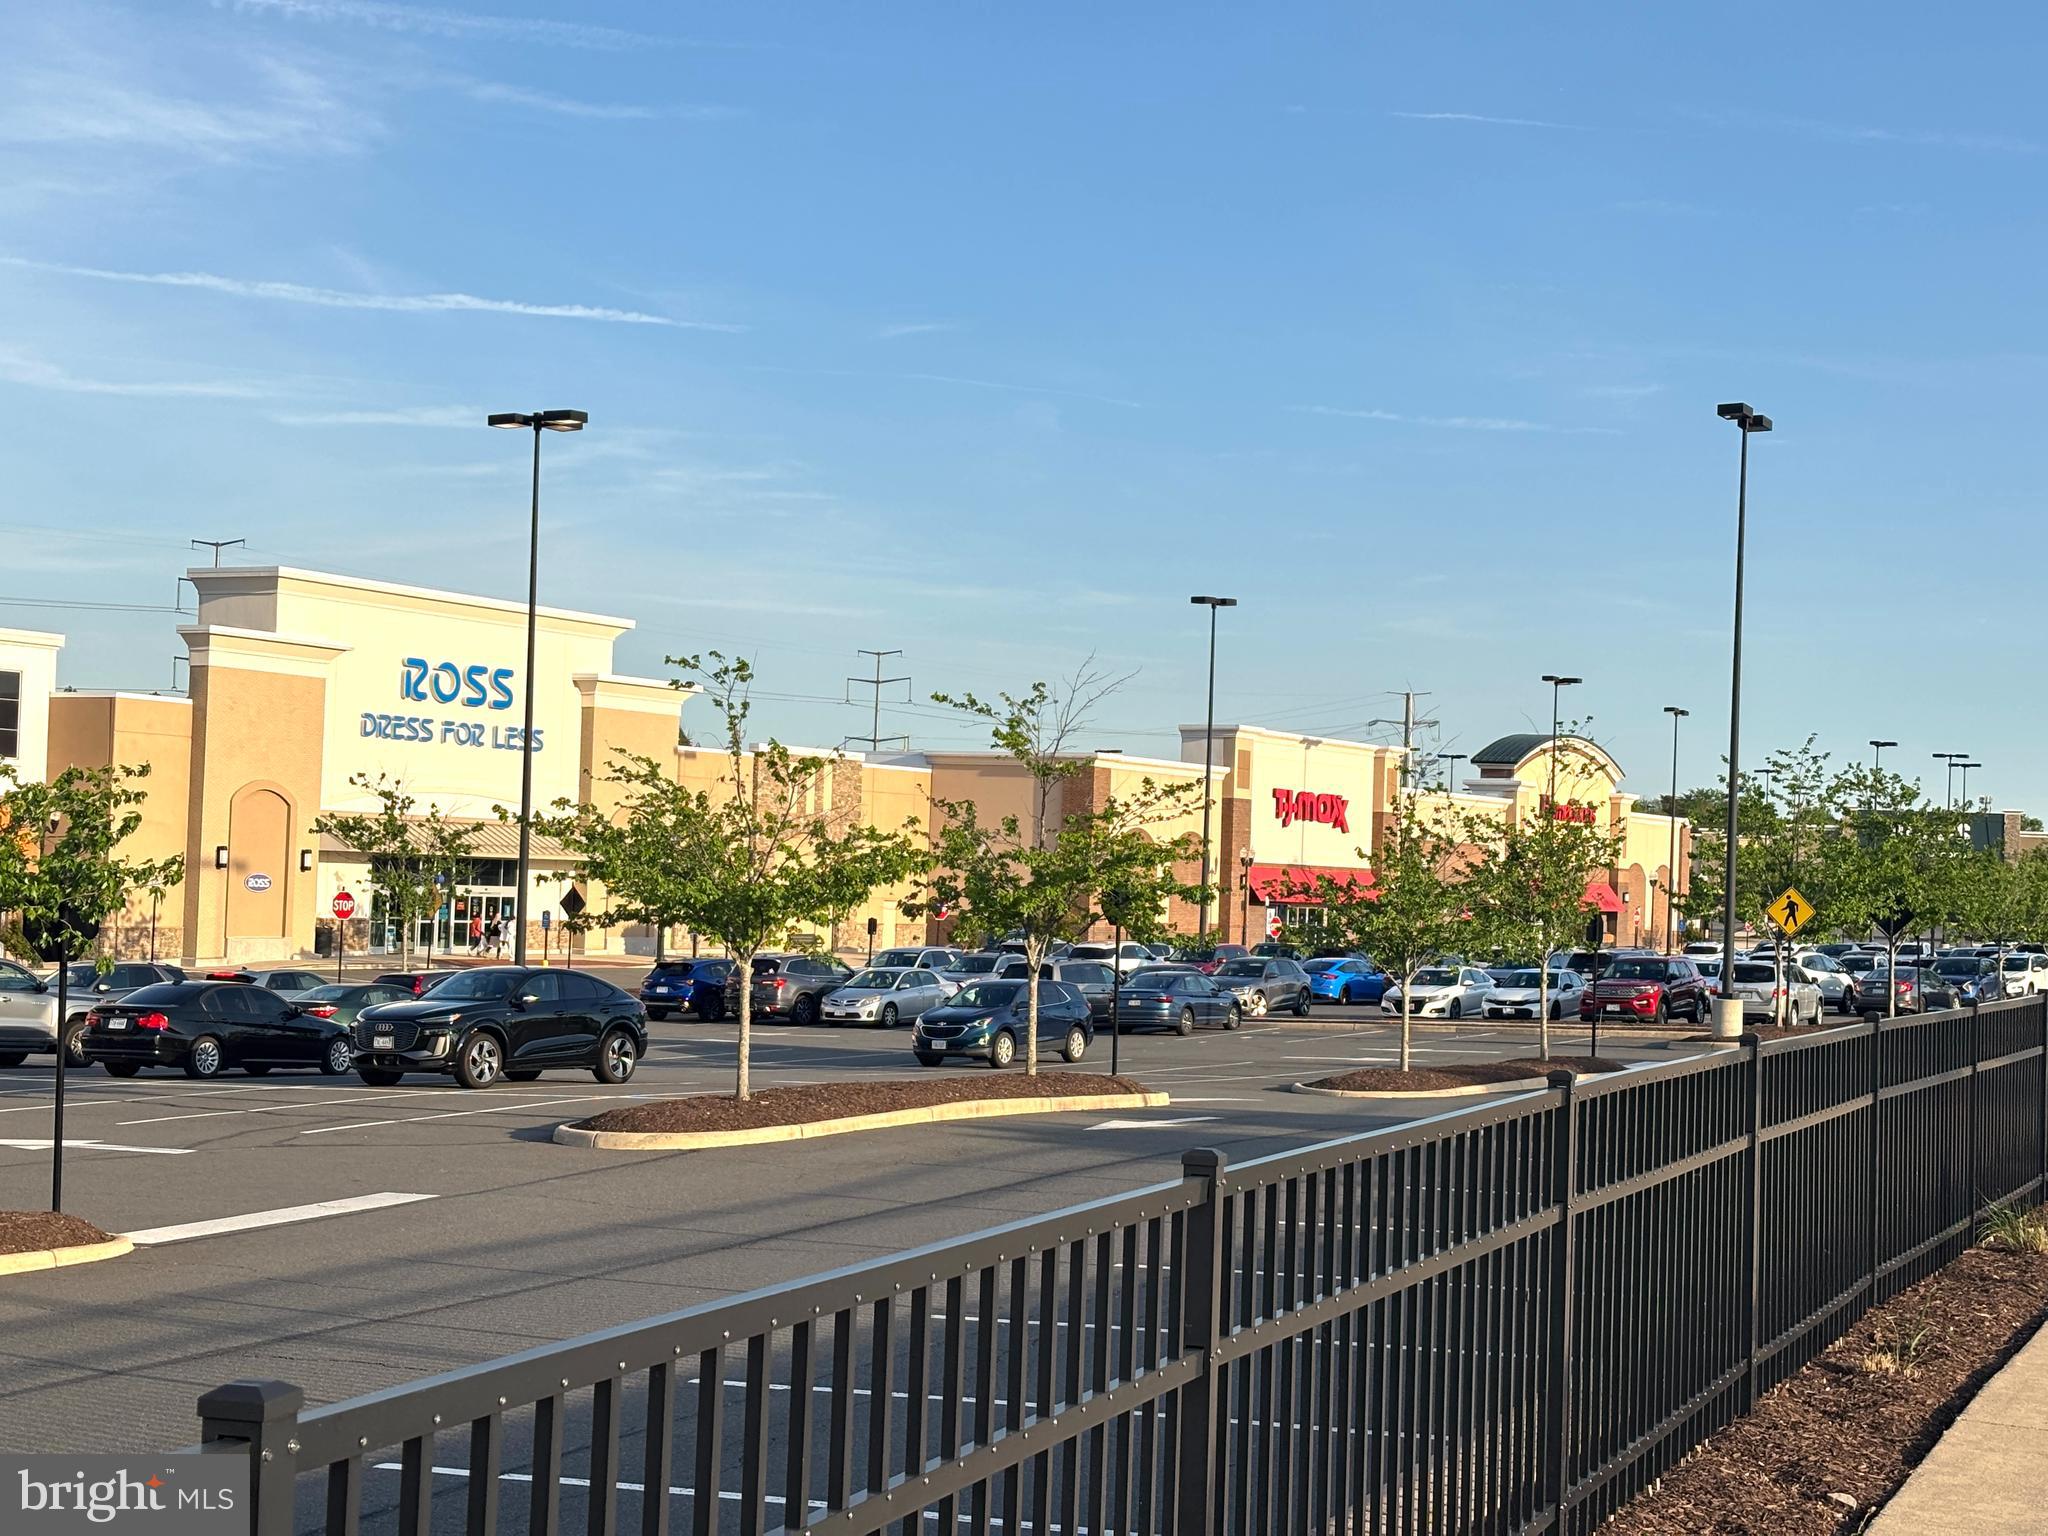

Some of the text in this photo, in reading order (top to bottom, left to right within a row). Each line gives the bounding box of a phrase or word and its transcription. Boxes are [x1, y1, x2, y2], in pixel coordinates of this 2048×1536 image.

[400, 657, 514, 710] ROSS
[360, 712, 544, 752] DRESS FOR LESS
[247, 878, 270, 888] ROSS
[333, 900, 354, 911] STOP
